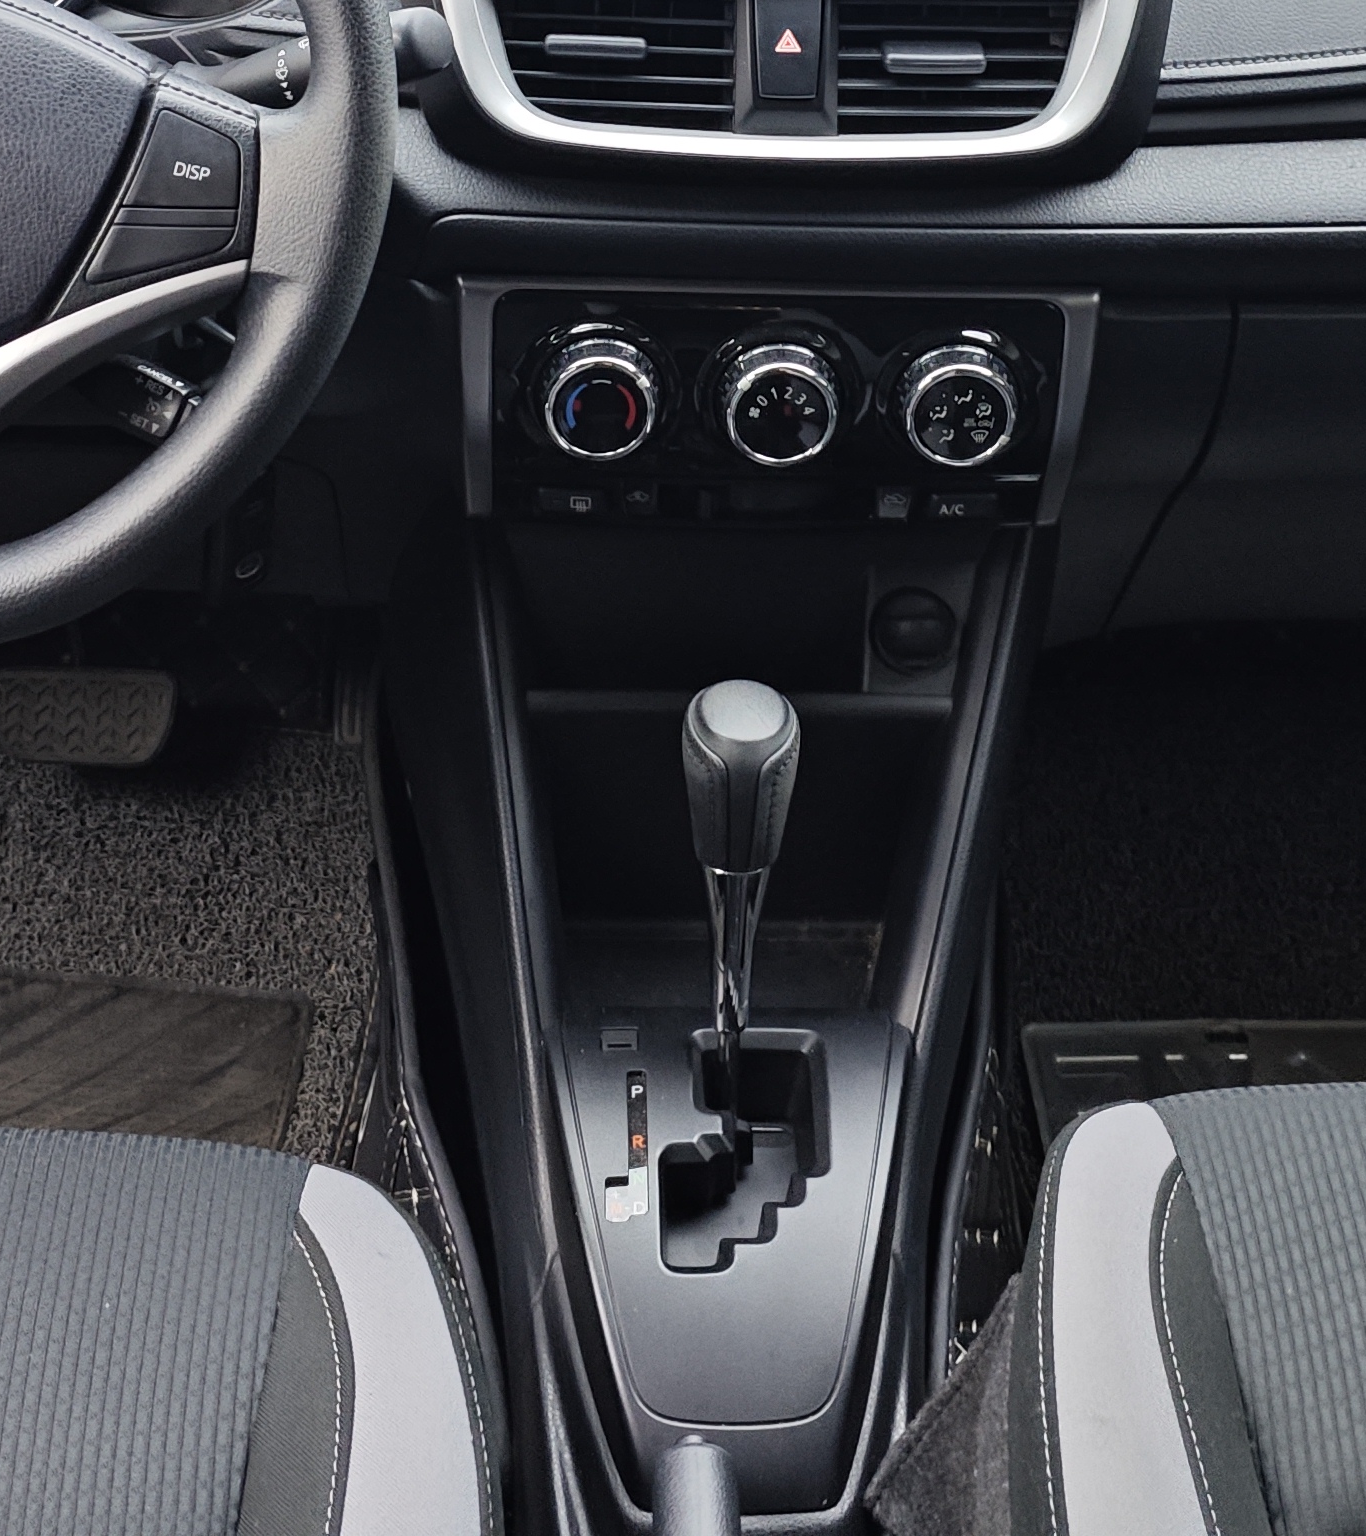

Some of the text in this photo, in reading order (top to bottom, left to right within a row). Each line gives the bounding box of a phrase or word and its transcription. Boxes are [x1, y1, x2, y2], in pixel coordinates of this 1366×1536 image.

[172, 160, 211, 181] DISP
[939, 503, 965, 516] A/C
[631, 1085, 644, 1099] P
[632, 1134, 646, 1149] R
[634, 1201, 646, 1215] D
